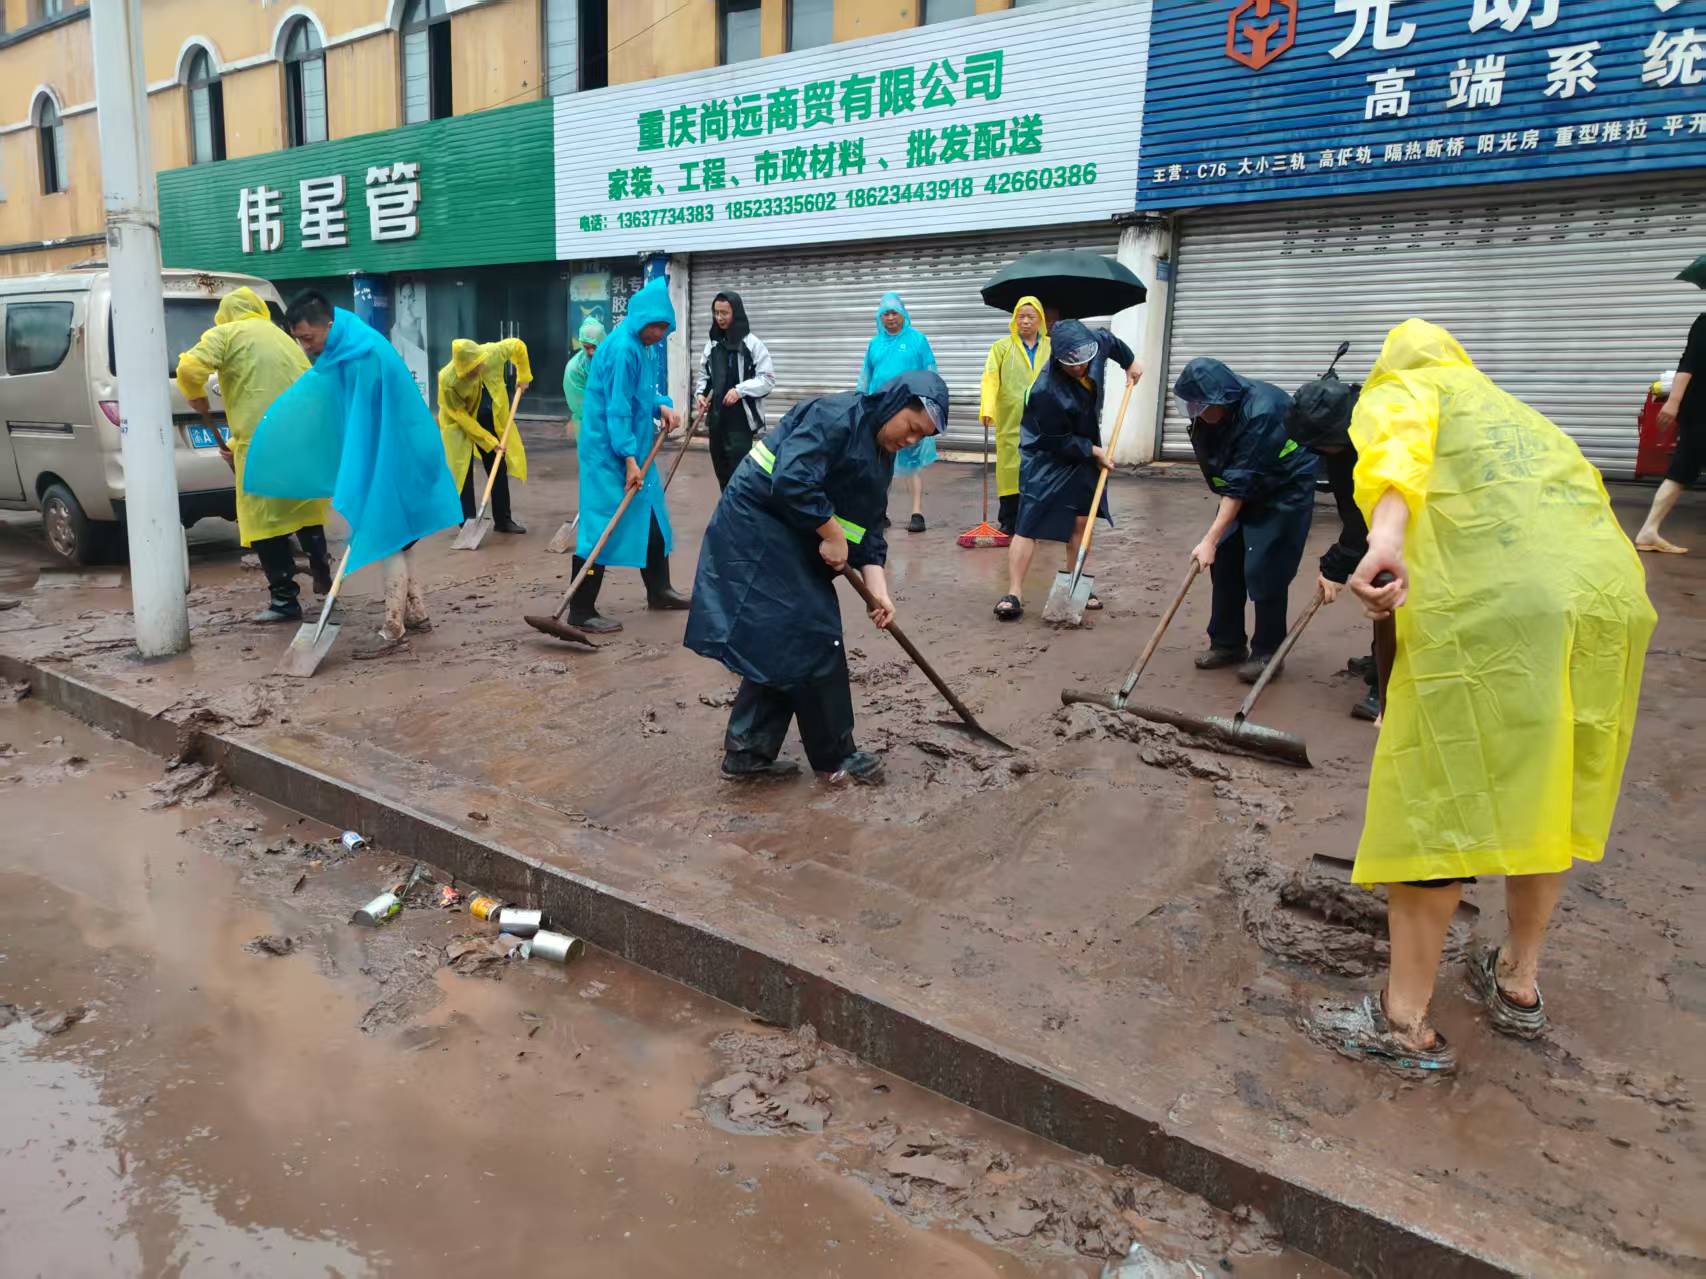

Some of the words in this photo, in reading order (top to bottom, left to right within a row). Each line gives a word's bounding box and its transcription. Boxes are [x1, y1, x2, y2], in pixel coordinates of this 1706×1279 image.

[637, 50, 1003, 151] 重庆尚远商贸有限公司
[1364, 28, 1706, 119] 高端系统
[608, 113, 1043, 200] 家装、工程、市政材料、批发配送
[1197, 163, 1227, 179] C76
[1237, 153, 1305, 176] 大小三轨
[1319, 145, 1373, 169] 高低轨
[1384, 137, 1465, 162] 隔热断桥
[1477, 129, 1540, 153] 阳光房
[1555, 118, 1648, 147] 重型推拉
[237, 161, 421, 253] 伟星管
[579, 213, 608, 232] 电话：
[617, 203, 714, 229] 13637734383
[725, 191, 837, 220] 18523335602
[845, 176, 974, 209] 18623443918
[984, 161, 1098, 195] 42660386
